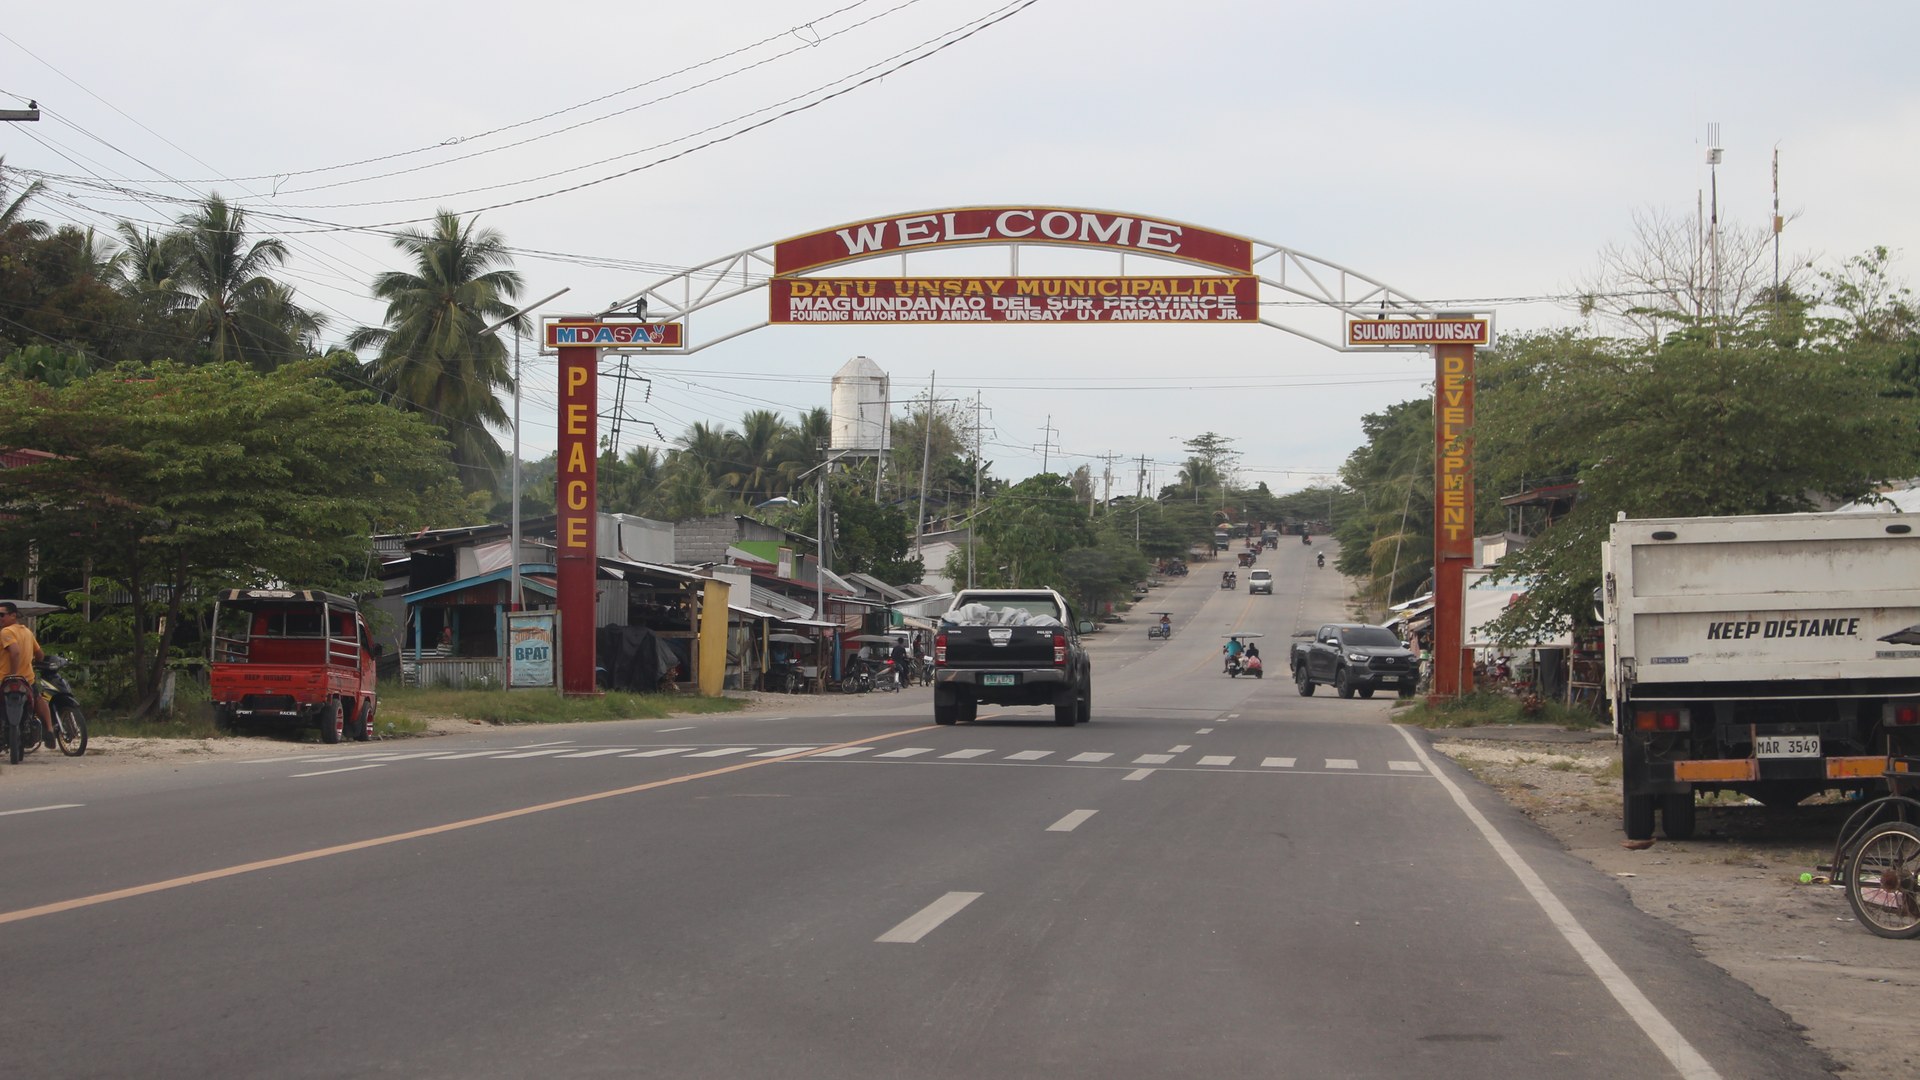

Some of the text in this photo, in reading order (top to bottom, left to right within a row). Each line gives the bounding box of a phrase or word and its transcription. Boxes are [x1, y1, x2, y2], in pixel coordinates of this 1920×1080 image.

[836, 210, 1183, 255] WELCOME
[789, 280, 1240, 297] DATU UNSAY MUNICIPALITY
[790, 296, 1237, 311] MAGUINDANAO DEL SUR PROVINCE
[790, 310, 849, 321] FOUNDING
[853, 310, 896, 321] MAYOR
[900, 310, 937, 320] DATU
[940, 310, 992, 320] ANDAL
[1077, 309, 1103, 320] UY
[1110, 309, 1208, 320] AMPATUAN
[1216, 309, 1242, 320] JR.
[1353, 323, 1482, 340] SULONG DATU UNSAY
[567, 366, 588, 549] PEACE
[1443, 357, 1465, 541] DEVELOPMENT
[1707, 618, 1860, 640] KEEP DISTANCE
[515, 647, 549, 661] BPAT
[1757, 740, 1818, 754] MAR 3549
